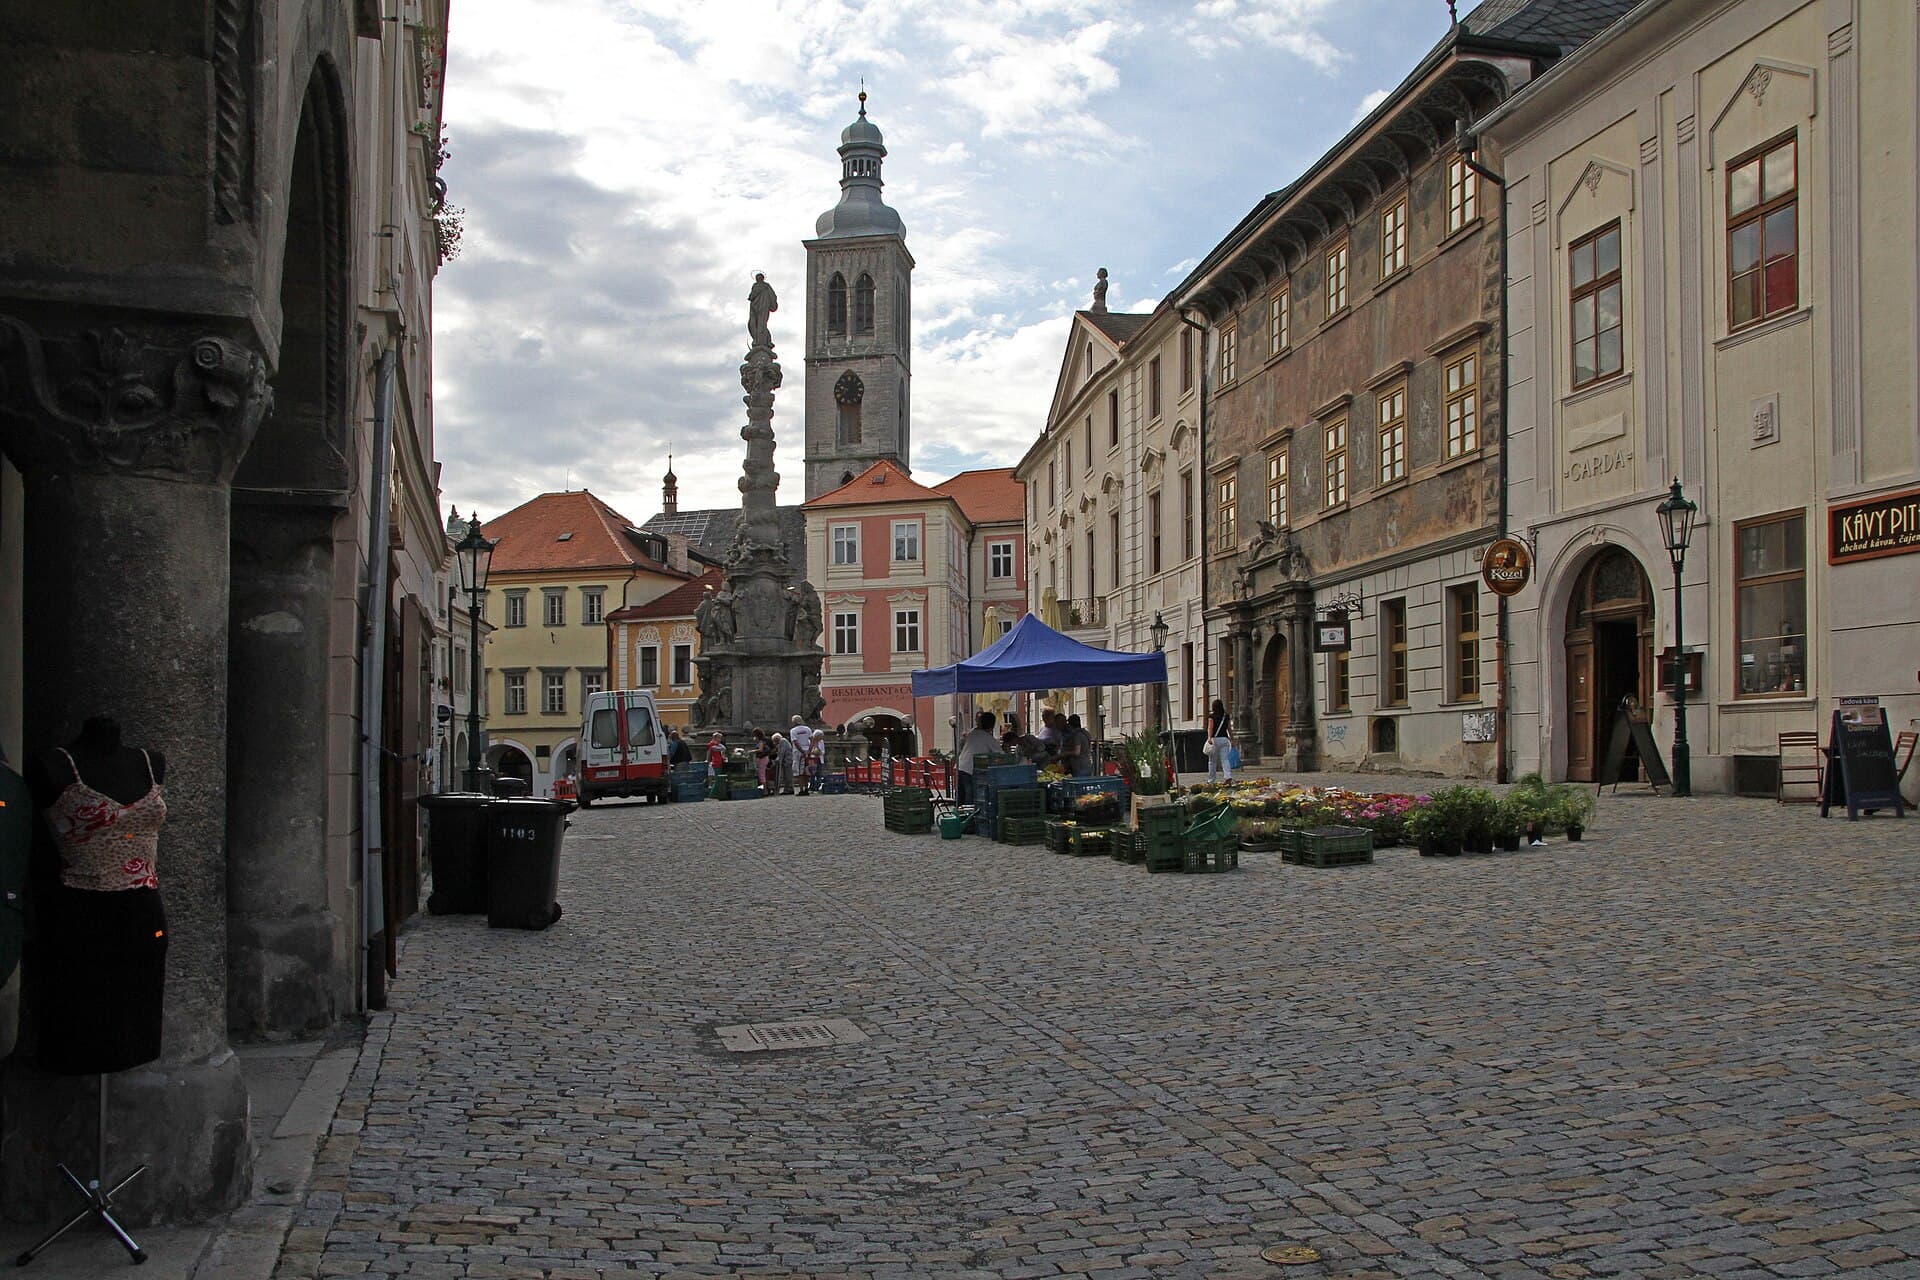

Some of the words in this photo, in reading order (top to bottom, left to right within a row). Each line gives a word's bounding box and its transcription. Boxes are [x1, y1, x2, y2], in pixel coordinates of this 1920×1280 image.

[1843, 509, 1887, 542] KÁVY
[1490, 568, 1523, 580] Kozel
[832, 687, 892, 697] RESTAURANT
